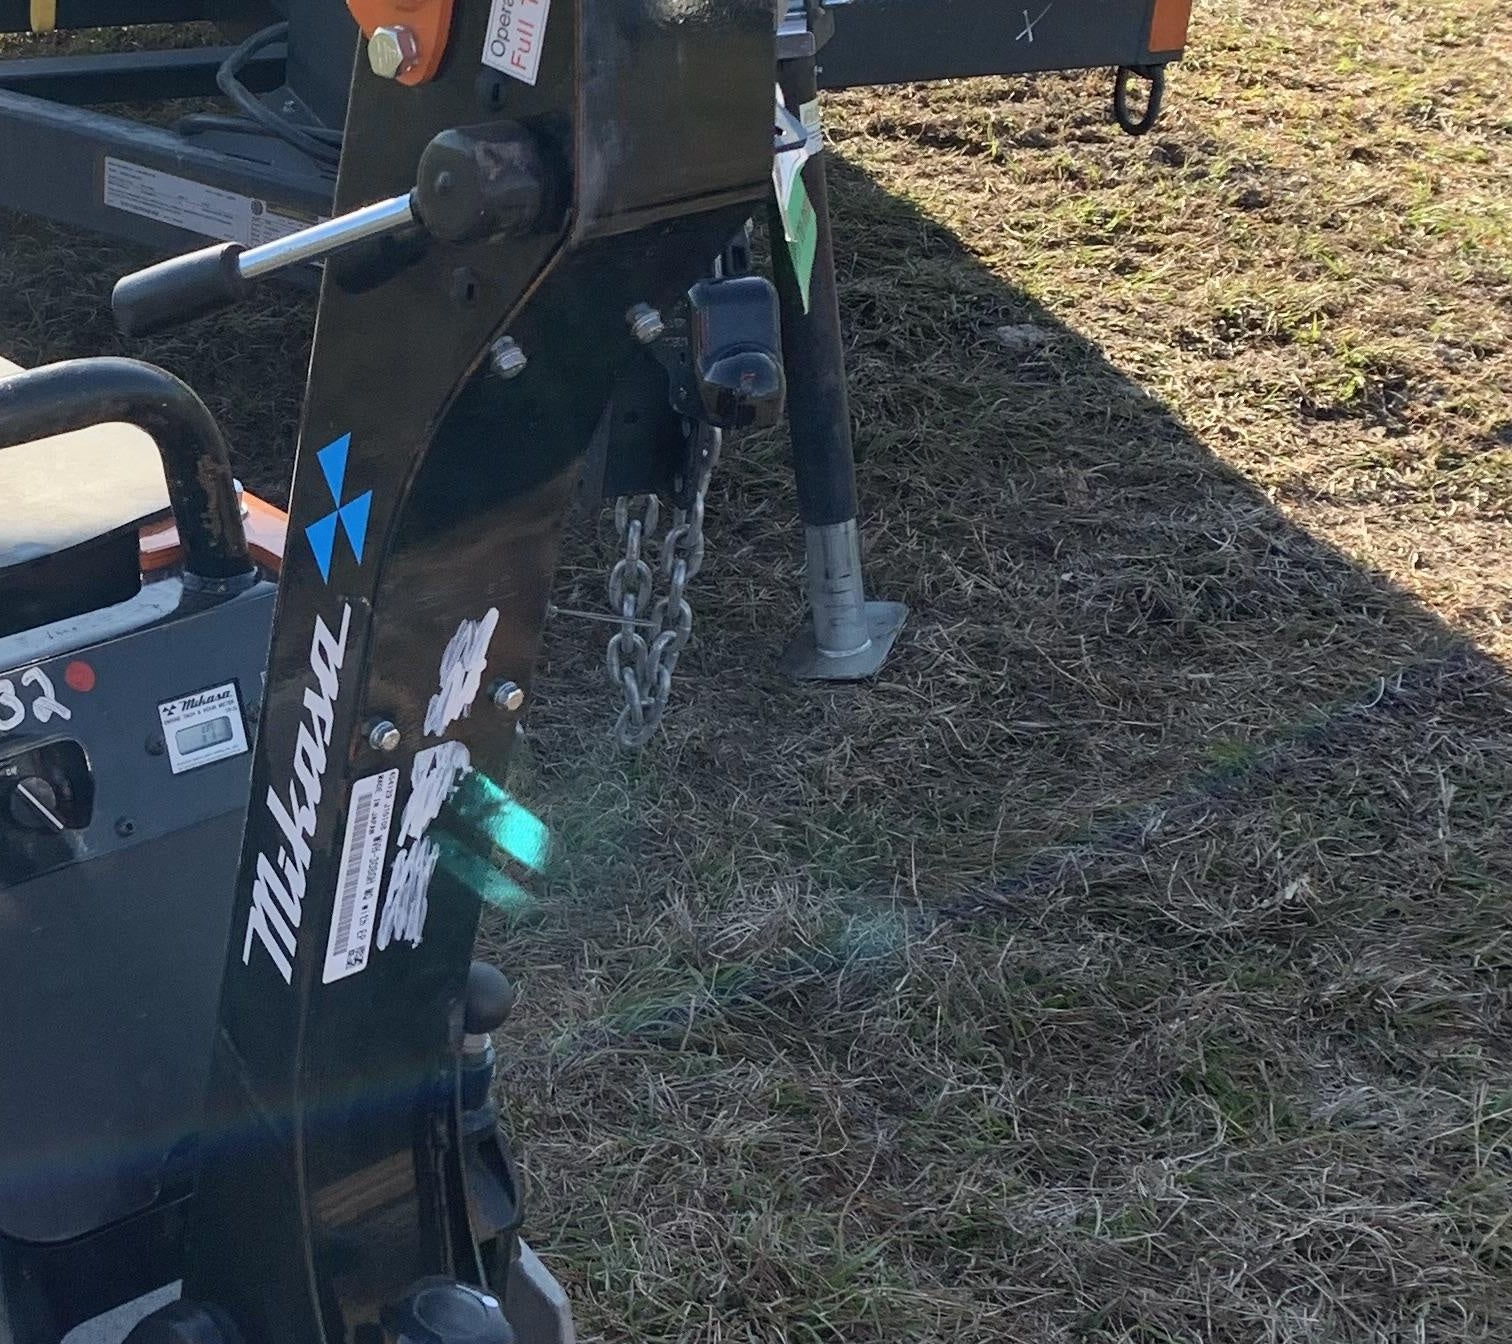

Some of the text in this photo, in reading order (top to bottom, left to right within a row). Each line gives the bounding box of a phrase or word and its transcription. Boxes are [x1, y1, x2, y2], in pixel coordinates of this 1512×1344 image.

[510, 19, 535, 71] Full
[179, 690, 231, 712] Mikasa
[243, 602, 352, 985] Mikasa
